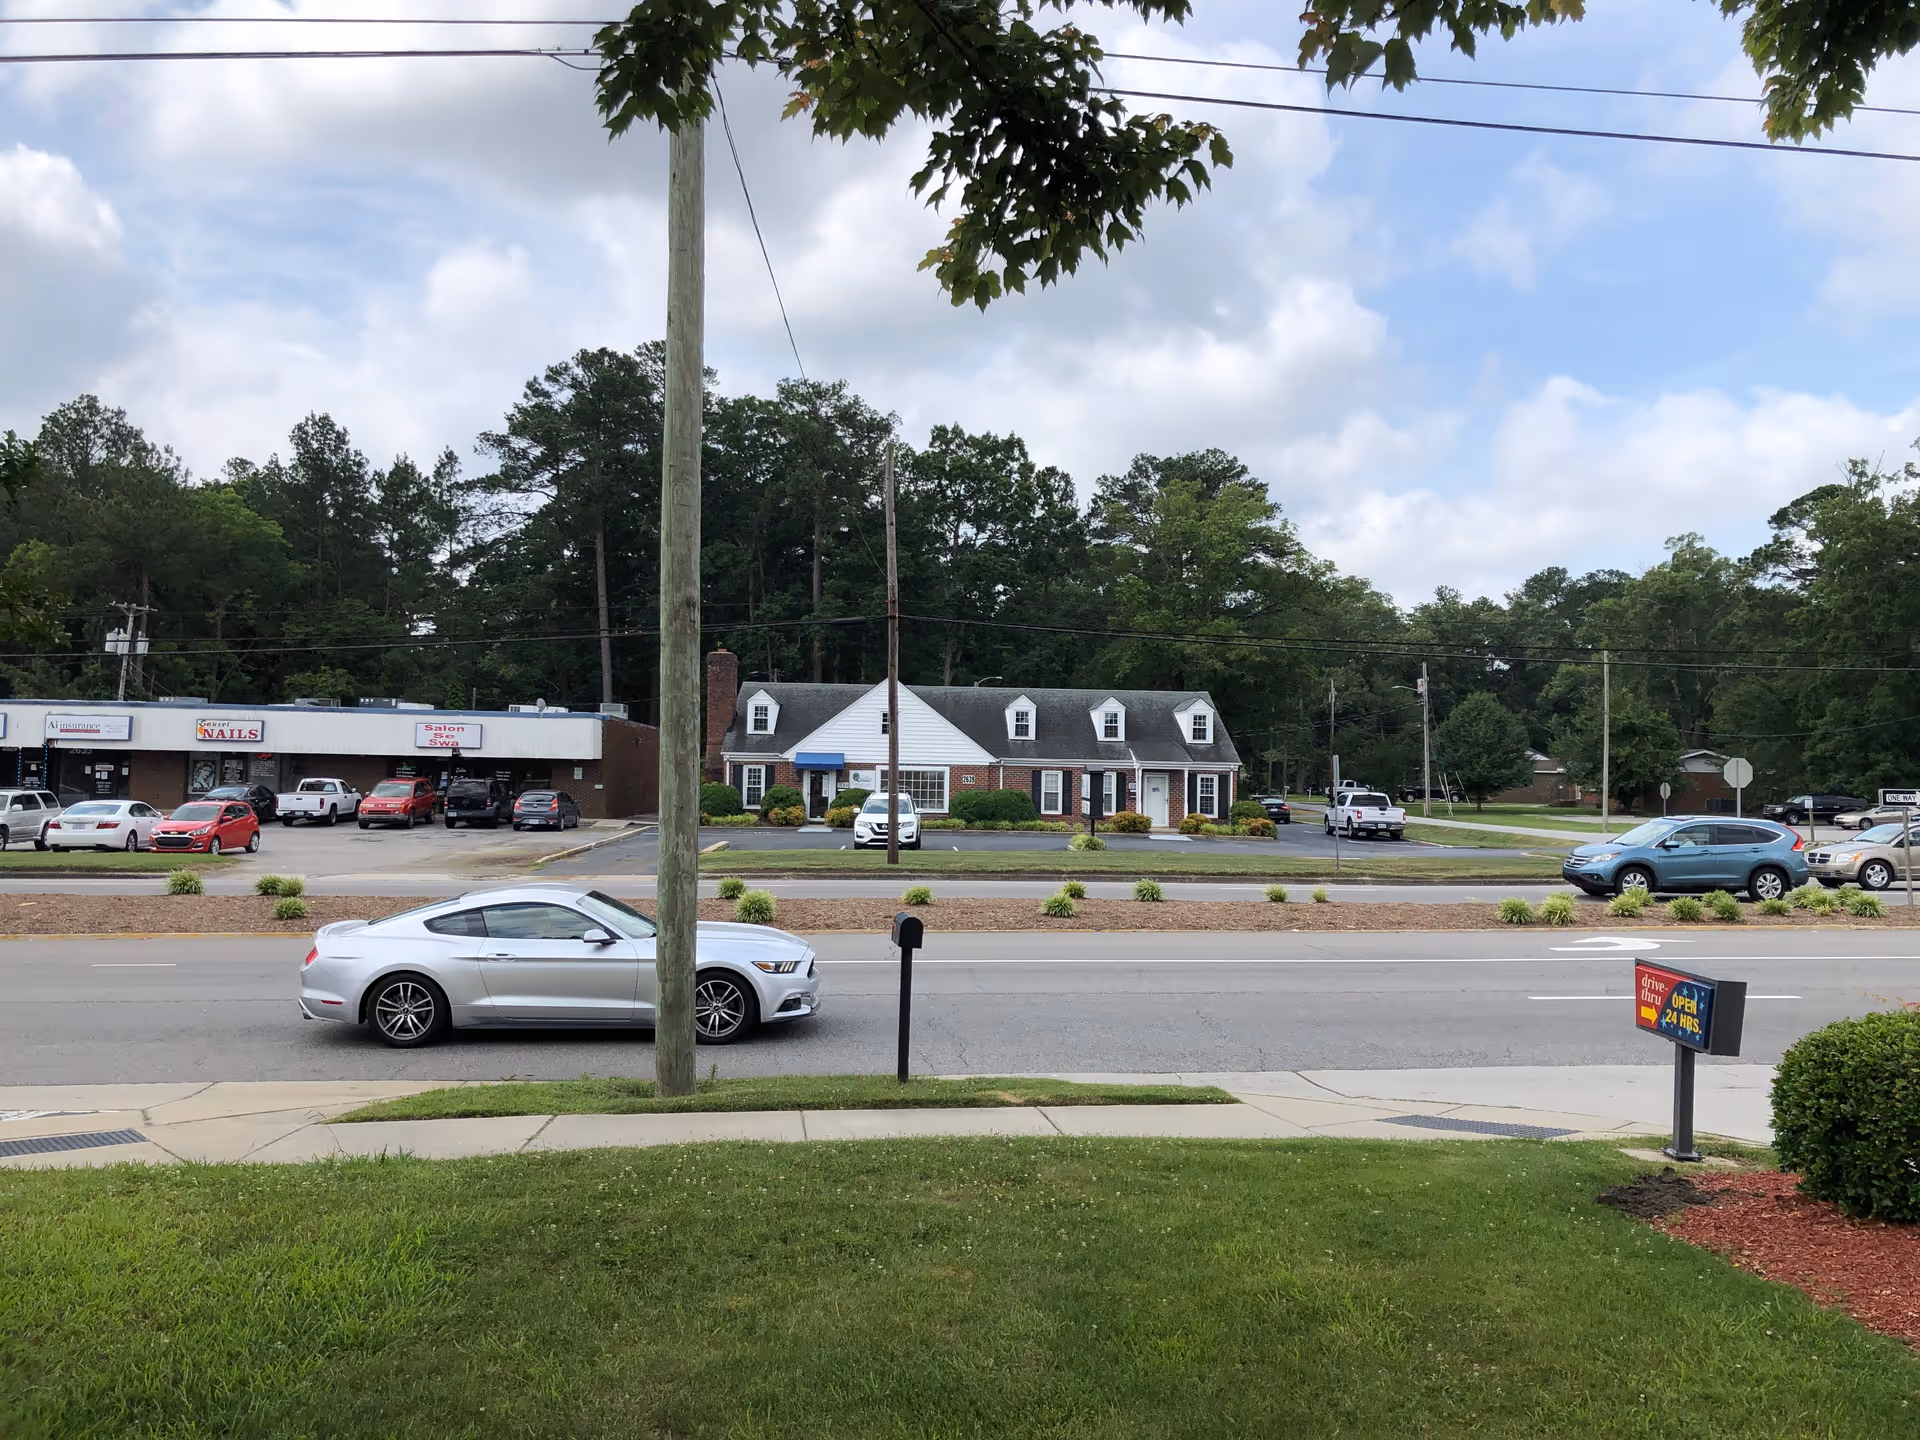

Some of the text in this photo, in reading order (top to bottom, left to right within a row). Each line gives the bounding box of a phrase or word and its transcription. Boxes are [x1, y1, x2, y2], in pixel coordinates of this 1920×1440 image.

[48, 721, 58, 729] Ai
[60, 721, 100, 729] insurance
[424, 724, 465, 732] Salon
[203, 728, 259, 739] NAILS
[429, 738, 459, 747] Swa
[1887, 794, 1917, 802] ONE WAY
[1641, 974, 1669, 993] drive-
[1641, 988, 1662, 1006] thru
[1671, 992, 1698, 1015] OPEN
[1665, 1009, 1703, 1034] 24 HRS.
